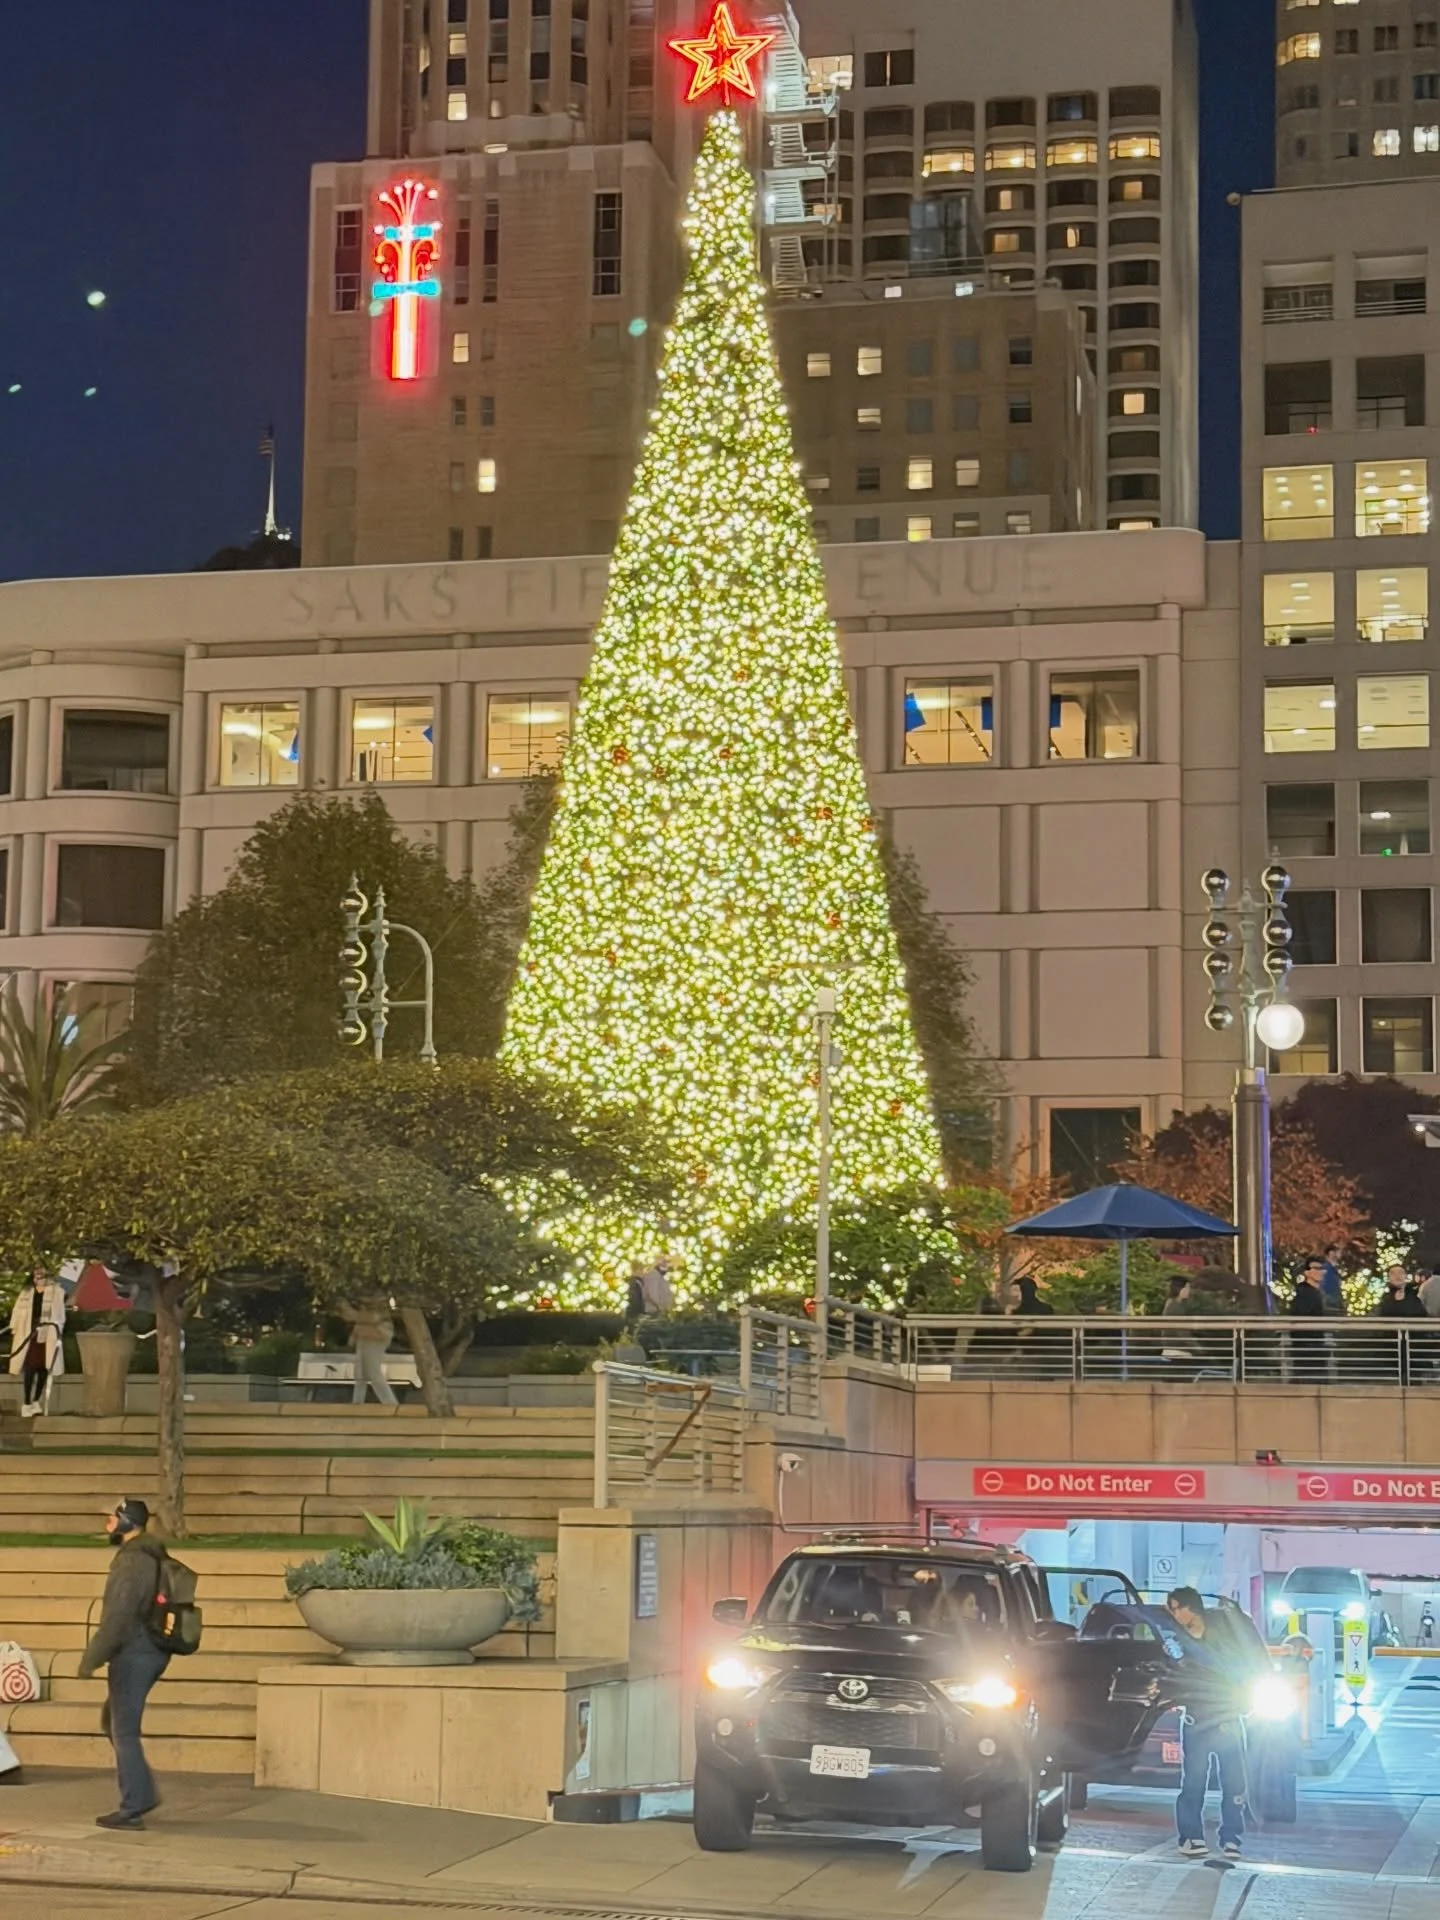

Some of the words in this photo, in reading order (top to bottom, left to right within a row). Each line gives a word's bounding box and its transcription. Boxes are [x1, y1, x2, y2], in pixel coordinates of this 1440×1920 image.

[284, 565, 457, 625] SAKS
[505, 562, 604, 618] FIF
[856, 541, 1053, 601] ENUE
[1026, 1473, 1054, 1491] Do
[1059, 1475, 1095, 1492] Not
[1100, 1475, 1152, 1493] Enter
[1352, 1479, 1381, 1497] Do
[1388, 1480, 1426, 1497] Not
